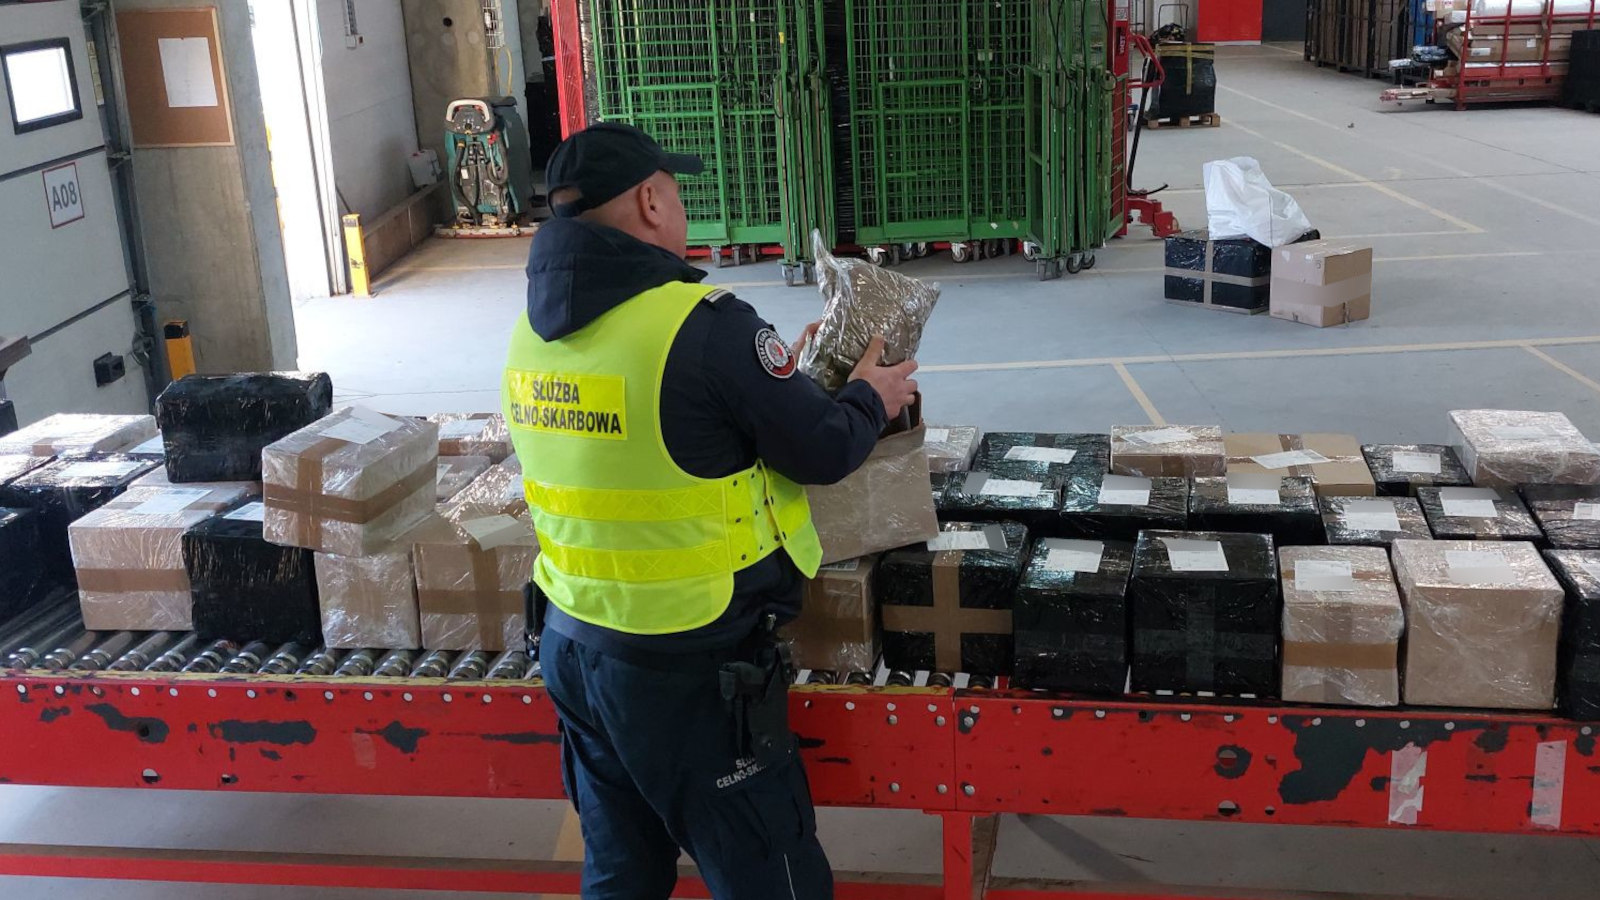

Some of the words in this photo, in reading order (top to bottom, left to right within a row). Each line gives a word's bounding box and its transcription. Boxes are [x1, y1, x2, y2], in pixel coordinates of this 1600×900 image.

[52, 181, 77, 212] A08
[533, 377, 580, 404] SŁUŻBA
[511, 402, 622, 434] CELNO-SKARBOWA
